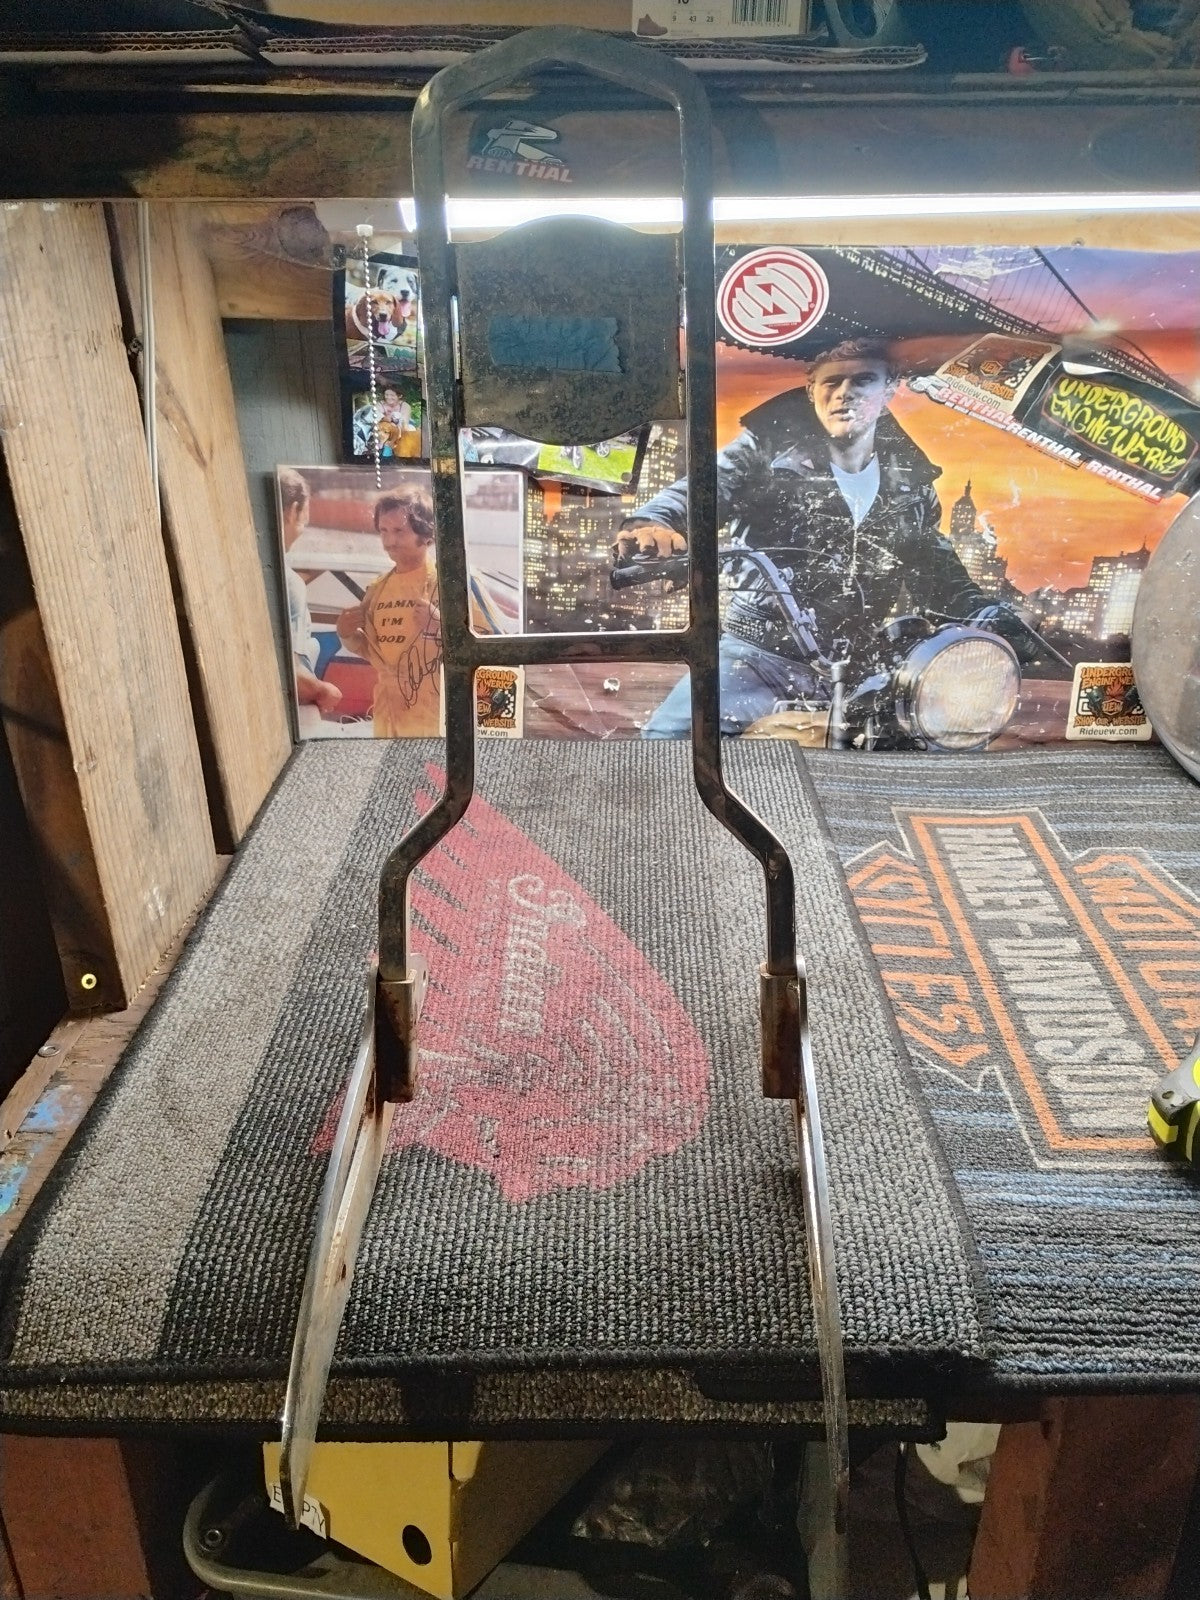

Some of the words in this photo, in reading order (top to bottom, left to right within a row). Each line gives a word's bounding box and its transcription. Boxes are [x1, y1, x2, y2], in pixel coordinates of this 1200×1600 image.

[466, 155, 573, 183] RENTHAL
[938, 386, 1016, 425] RENTHAL
[1058, 378, 1187, 453] UNDERGROUND
[1006, 422, 1083, 464] RENTHAL
[1051, 393, 1122, 446] ENGINE
[1111, 428, 1187, 474] WERKZ
[1086, 460, 1164, 499] RENTHAL
[377, 600, 415, 611] DAMN
[382, 617, 404, 627] I'M
[1080, 728, 1138, 736] Rideuew.com
[936, 827, 1163, 1129] HARLEY-DAVIDSON
